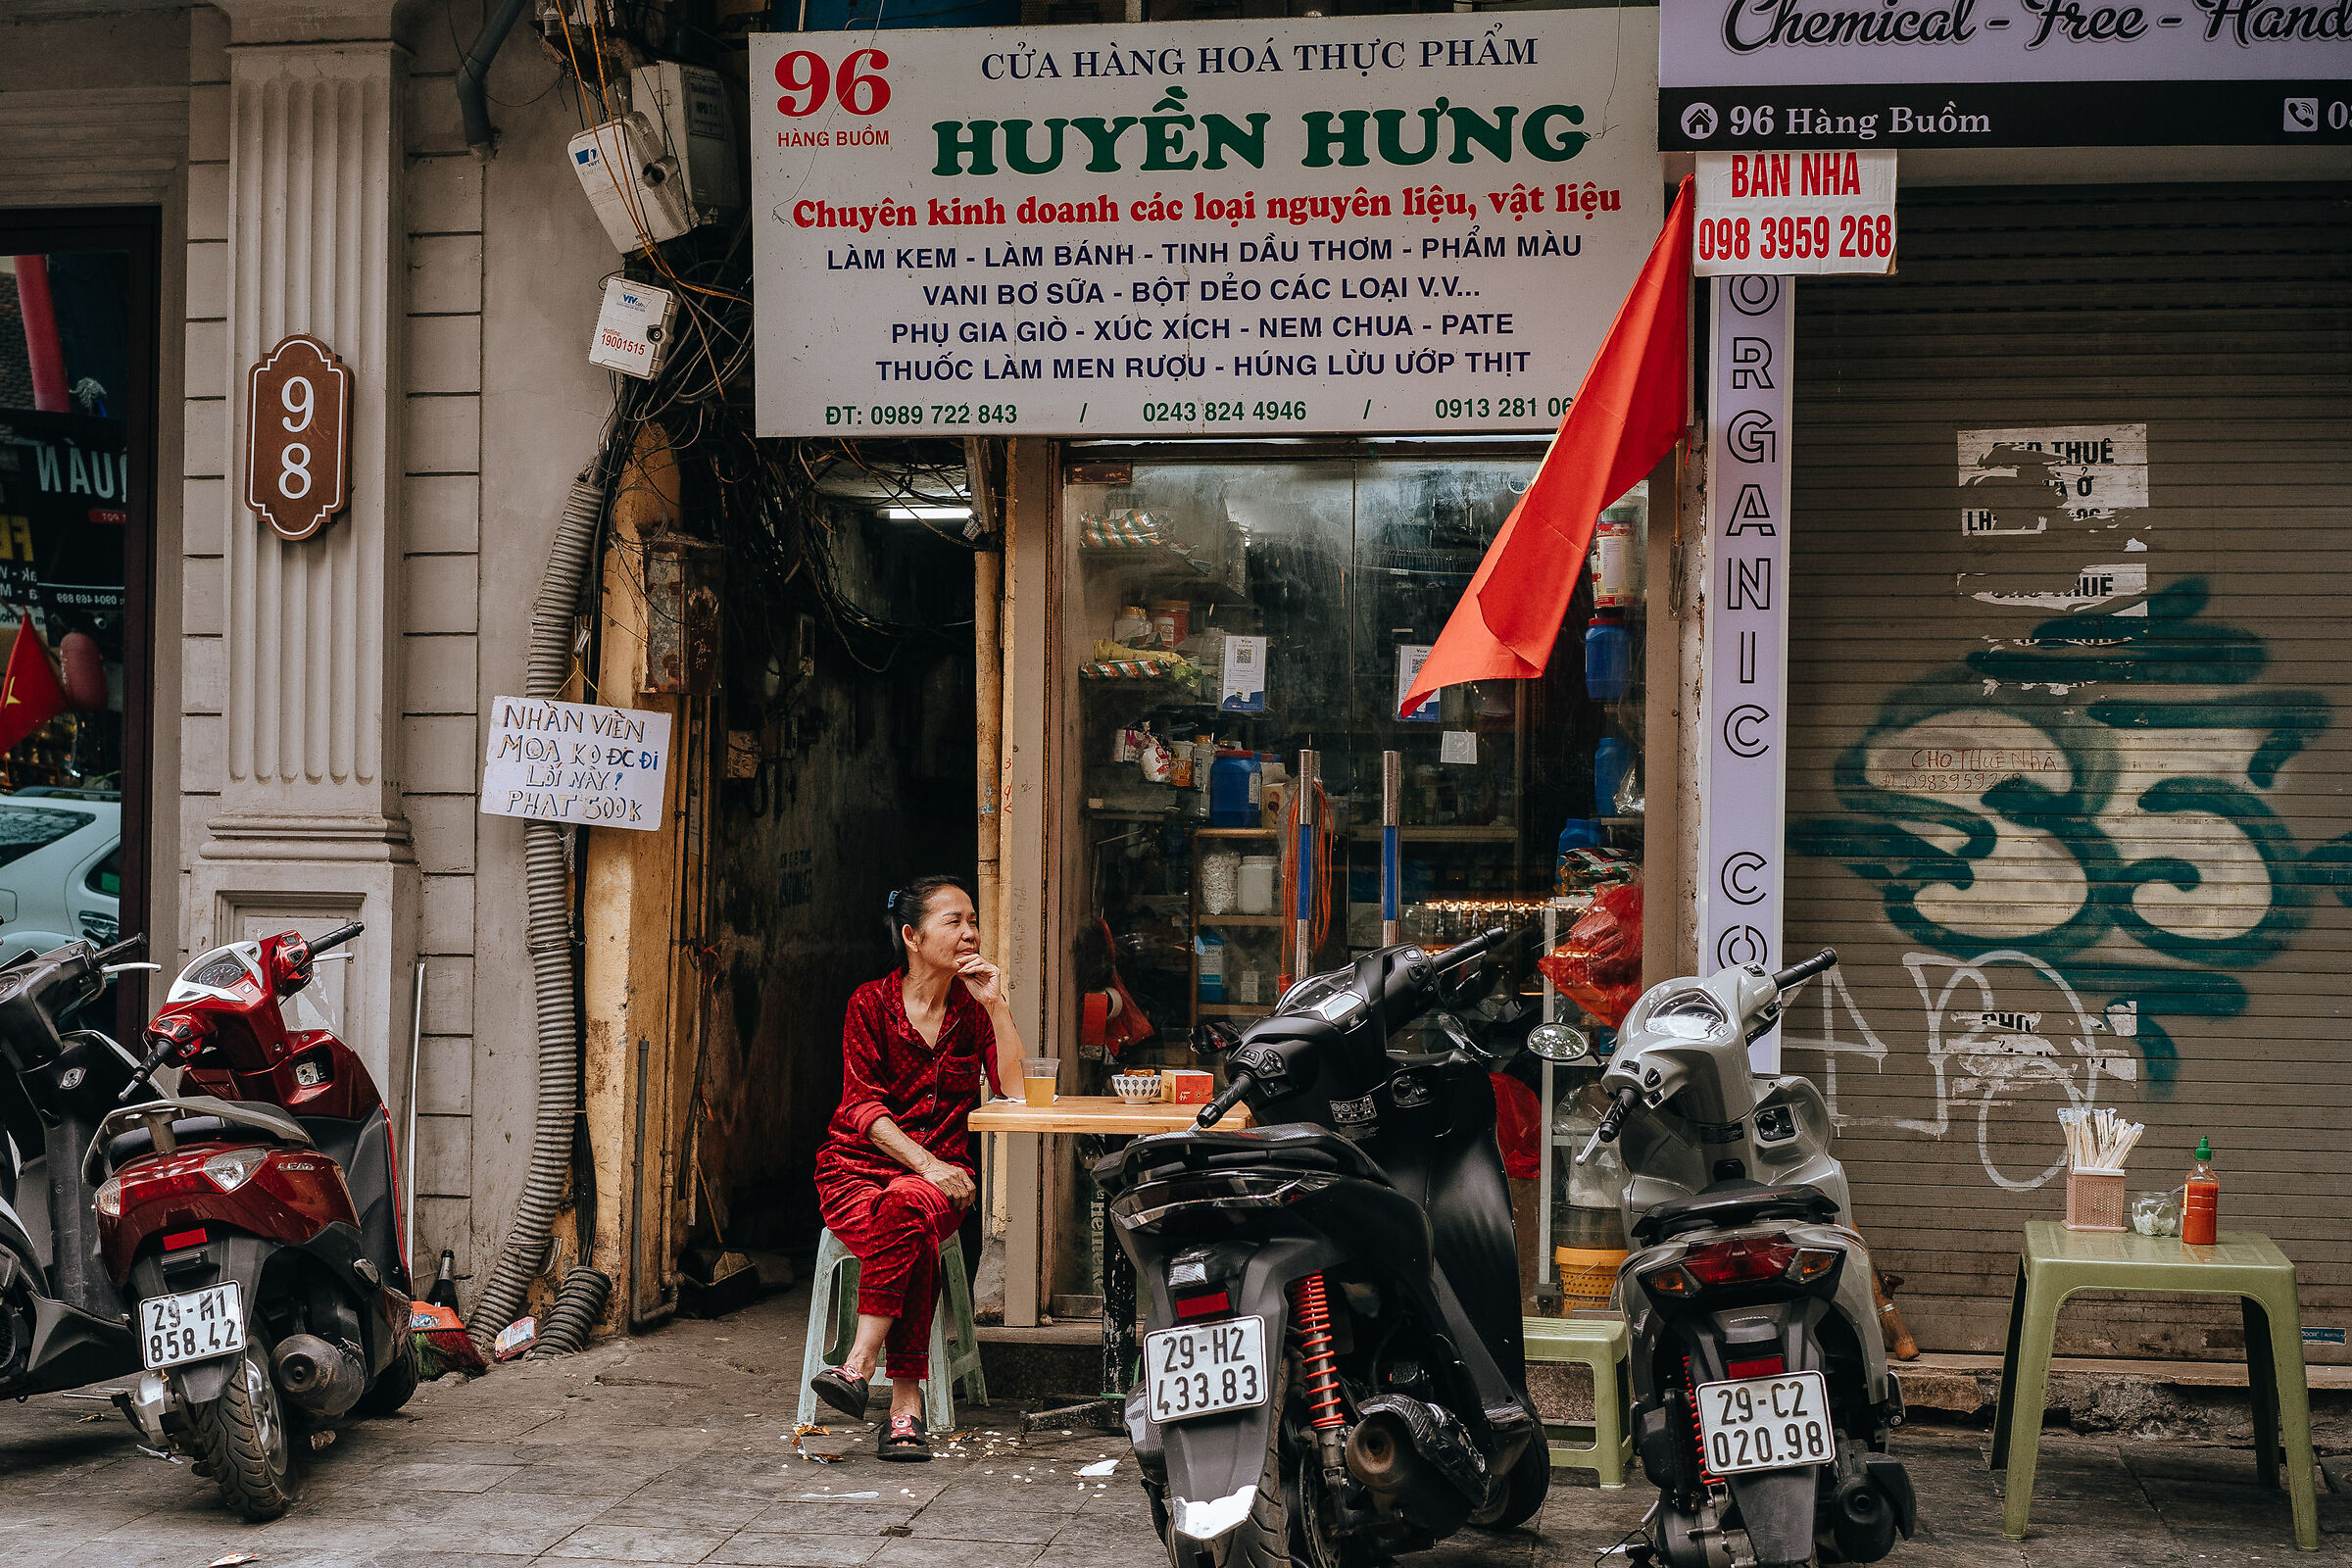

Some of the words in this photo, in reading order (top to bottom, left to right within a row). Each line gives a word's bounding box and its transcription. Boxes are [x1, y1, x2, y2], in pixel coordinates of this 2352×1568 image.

[1722, 0, 1972, 53] Chemical
[2023, 0, 2150, 49] Free
[982, 41, 1061, 80] CỬA
[1072, 42, 1183, 77] HÀNG
[1198, 37, 1282, 74] HOÁ
[1294, 37, 1405, 76] THỰC
[1419, 23, 1539, 68] PHẨM
[774, 49, 891, 117] 96
[777, 126, 830, 148] HÀNG
[836, 123, 890, 147] BUỒM
[932, 86, 1271, 176] HUYỀN
[1301, 96, 1591, 168] HƯNG
[1729, 105, 1775, 137] 96
[1785, 106, 1877, 139] Hàng
[1888, 100, 1991, 135] Buồm
[793, 198, 917, 232] Chuyên
[927, 197, 1006, 225] kinh
[1017, 196, 1119, 224] doanh
[1130, 192, 1184, 222] các
[1195, 191, 1256, 228] loại
[1267, 186, 1392, 224] nguyên
[1402, 185, 1477, 223] liệu,
[1488, 183, 1544, 220] vật
[1555, 181, 1621, 220] liệu
[827, 244, 884, 270] LÀM
[896, 247, 956, 269] KEM
[985, 241, 1043, 267] LÀM
[1054, 240, 1135, 266] BÁNH
[1161, 242, 1229, 264] TINH
[1240, 232, 1298, 264] DẦU
[1308, 238, 1392, 262] THƠM
[1422, 225, 1505, 259] PHẨM
[1516, 234, 1582, 257] MÀU
[1699, 218, 1750, 260] 098
[1760, 216, 1830, 259] 3959
[1839, 215, 1891, 258] 268
[923, 284, 987, 306] VANI
[998, 281, 1038, 305] BƠ
[1047, 277, 1104, 304] SỮA
[1132, 276, 1191, 307] BỘT
[1200, 271, 1261, 302] DẺO
[1269, 272, 1331, 300] CÁC
[1342, 276, 1407, 303] LOẠI
[1418, 275, 1480, 298] V.V...
[601, 333, 646, 356] 19001515
[892, 322, 949, 348] PHỤ
[958, 321, 1007, 343] GIA
[1016, 316, 1068, 342] GIÒ
[1094, 316, 1152, 341] XÚC
[1162, 314, 1230, 339] XÍCH
[1259, 316, 1322, 338] NEM
[1333, 314, 1413, 337] CHUA
[1442, 313, 1513, 335] PATE
[875, 352, 973, 381] THUỐC
[984, 353, 1043, 379] LÀM
[1054, 358, 1114, 379] MEN
[1125, 356, 1205, 382] RƯỢU
[1234, 349, 1317, 376] HÚNG
[1328, 348, 1385, 375] LỪU
[1396, 347, 1455, 373] ƯỚP
[1465, 351, 1531, 377] THỊT
[825, 406, 862, 425] ĐT:
[871, 406, 923, 425] 0989
[933, 405, 970, 424] 722
[978, 404, 1017, 424] 843
[1143, 402, 1197, 422] 0243
[1204, 401, 1245, 421] 824
[1252, 400, 1307, 420] 4946
[1436, 398, 1491, 418] 0913
[1498, 397, 1538, 417] 281
[278, 375, 315, 500] 98
[1724, 276, 1779, 758] ORGANIC
[1912, 749, 1952, 768] CHO
[153, 1289, 226, 1331] 29-M1
[150, 1319, 238, 1363] 858.42
[1162, 1327, 1246, 1373] 29-H2
[1156, 1365, 1257, 1415] 433.83
[1717, 1381, 1808, 1425] 29-C2
[1712, 1421, 1824, 1467] 020.98
